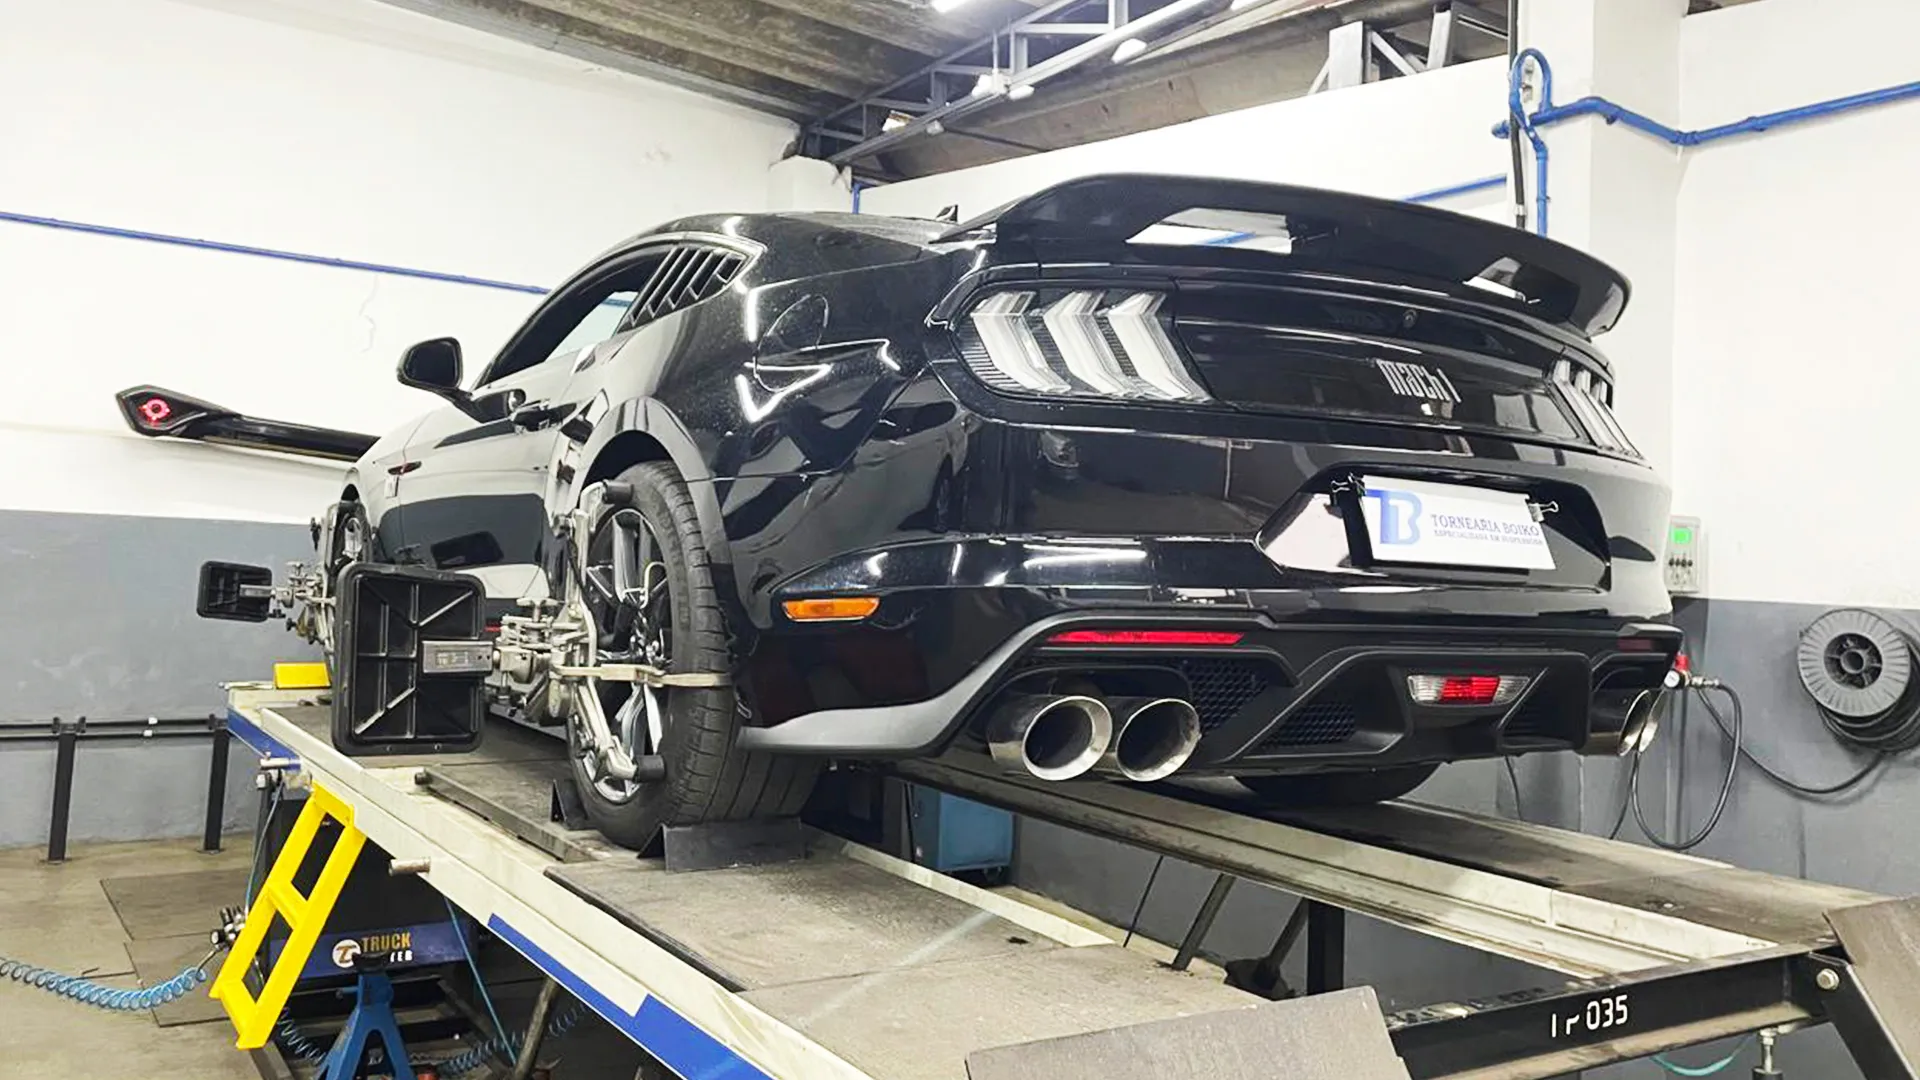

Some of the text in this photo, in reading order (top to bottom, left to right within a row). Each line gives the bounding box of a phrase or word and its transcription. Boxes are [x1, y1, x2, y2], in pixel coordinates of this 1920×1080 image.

[1430, 513, 1540, 536] TORNEARIA BOIKO
[361, 932, 411, 952] TRUCK
